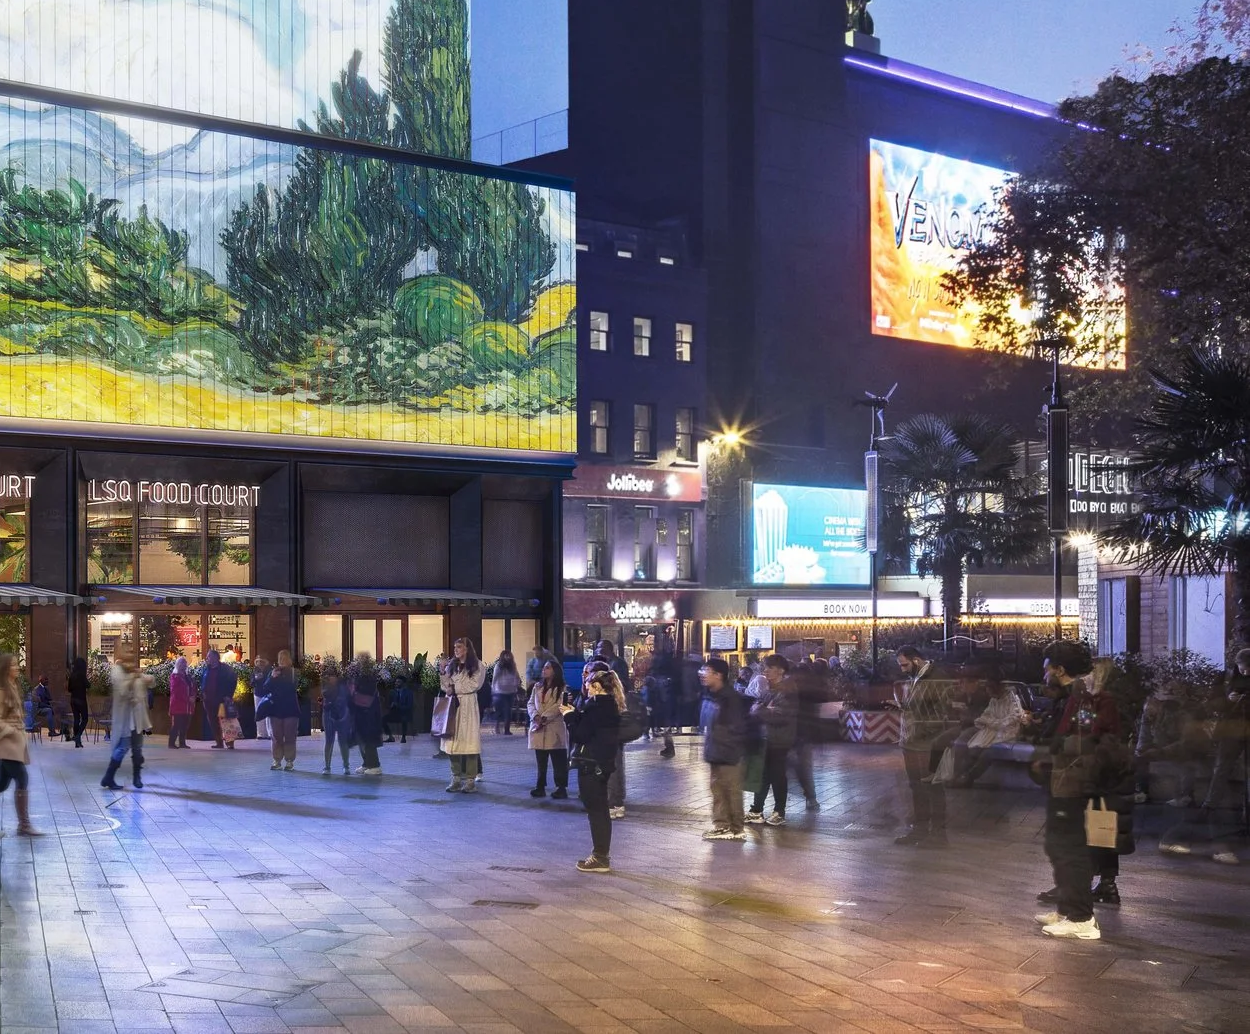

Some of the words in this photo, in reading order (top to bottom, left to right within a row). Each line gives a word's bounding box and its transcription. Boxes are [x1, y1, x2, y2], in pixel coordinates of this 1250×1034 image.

[607, 473, 654, 492] Jollibee
[89, 479, 132, 502] LSQ
[138, 481, 192, 505] FOOD
[197, 484, 261, 507] COURT
[610, 601, 658, 619] Jollibee
[823, 604, 847, 614] BOOK
[848, 605, 868, 614] NOW
